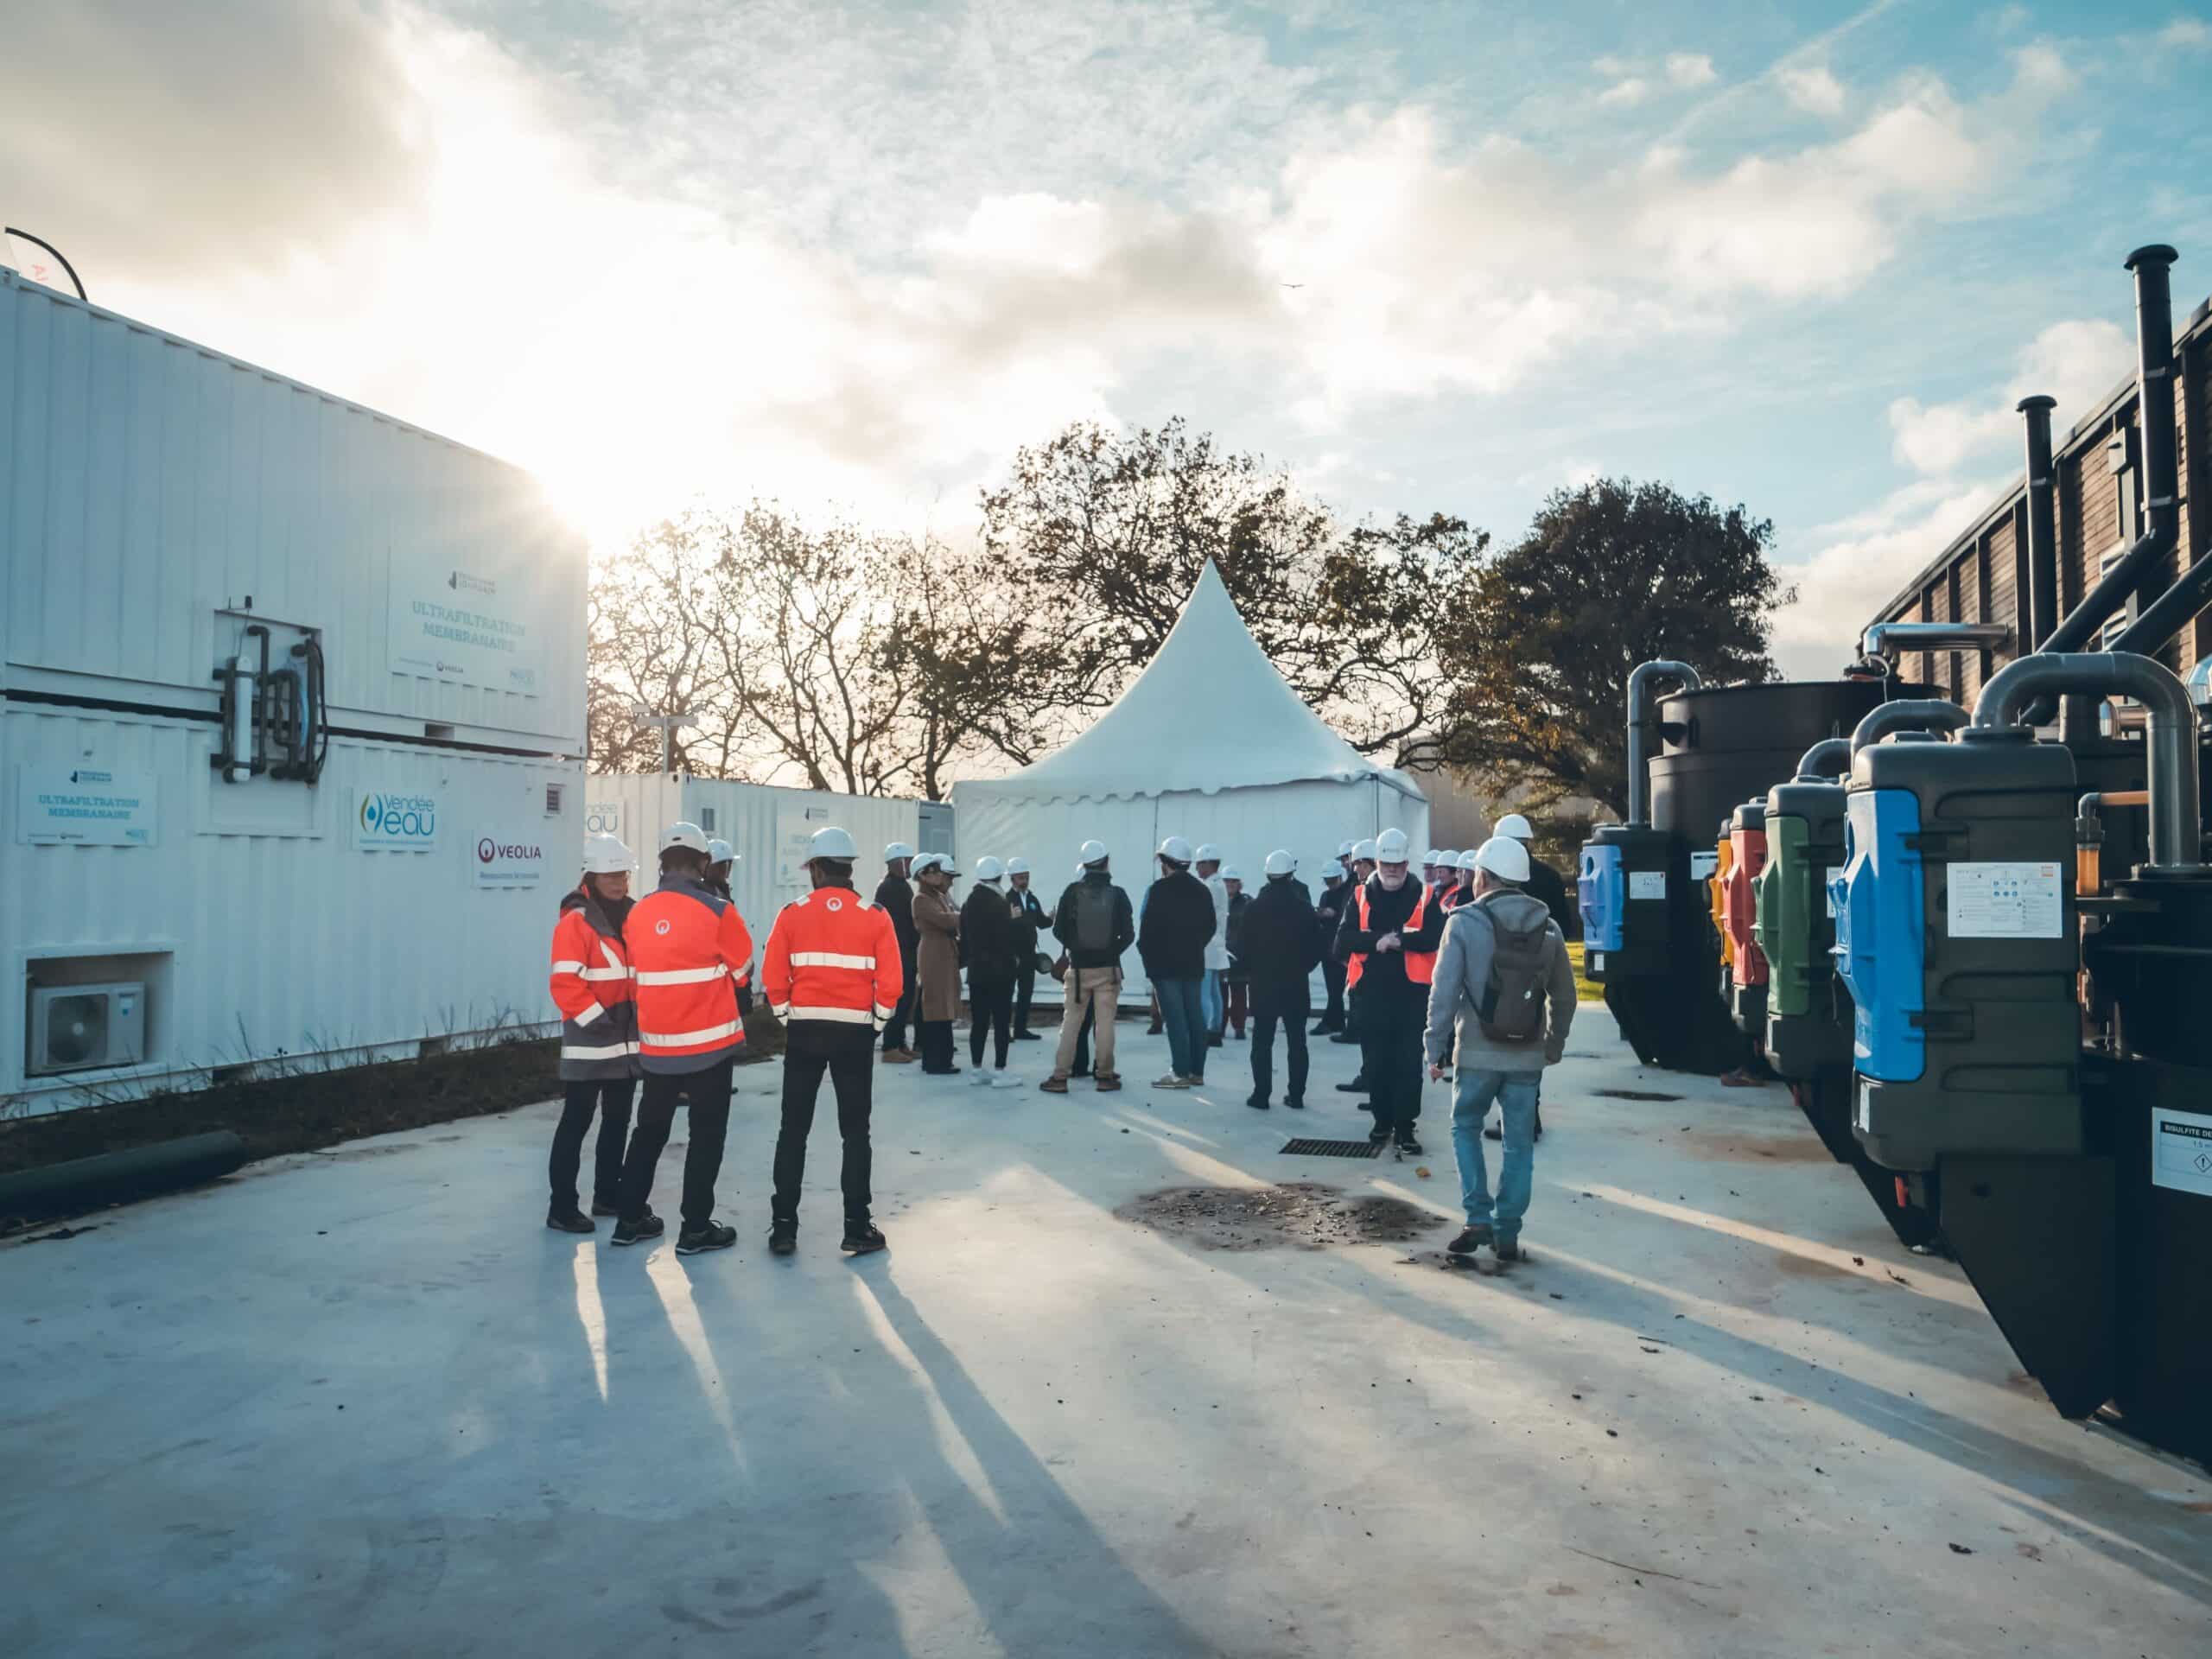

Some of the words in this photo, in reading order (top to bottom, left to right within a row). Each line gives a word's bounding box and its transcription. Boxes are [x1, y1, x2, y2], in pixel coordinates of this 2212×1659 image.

[39, 794, 139, 808] ULTRAFILTRATION
[48, 808, 131, 820] MEMBRANAIRE
[385, 811, 435, 836] eau
[497, 844, 542, 859] VEOLIA
[2164, 1123, 2200, 1136] BISULFITE
